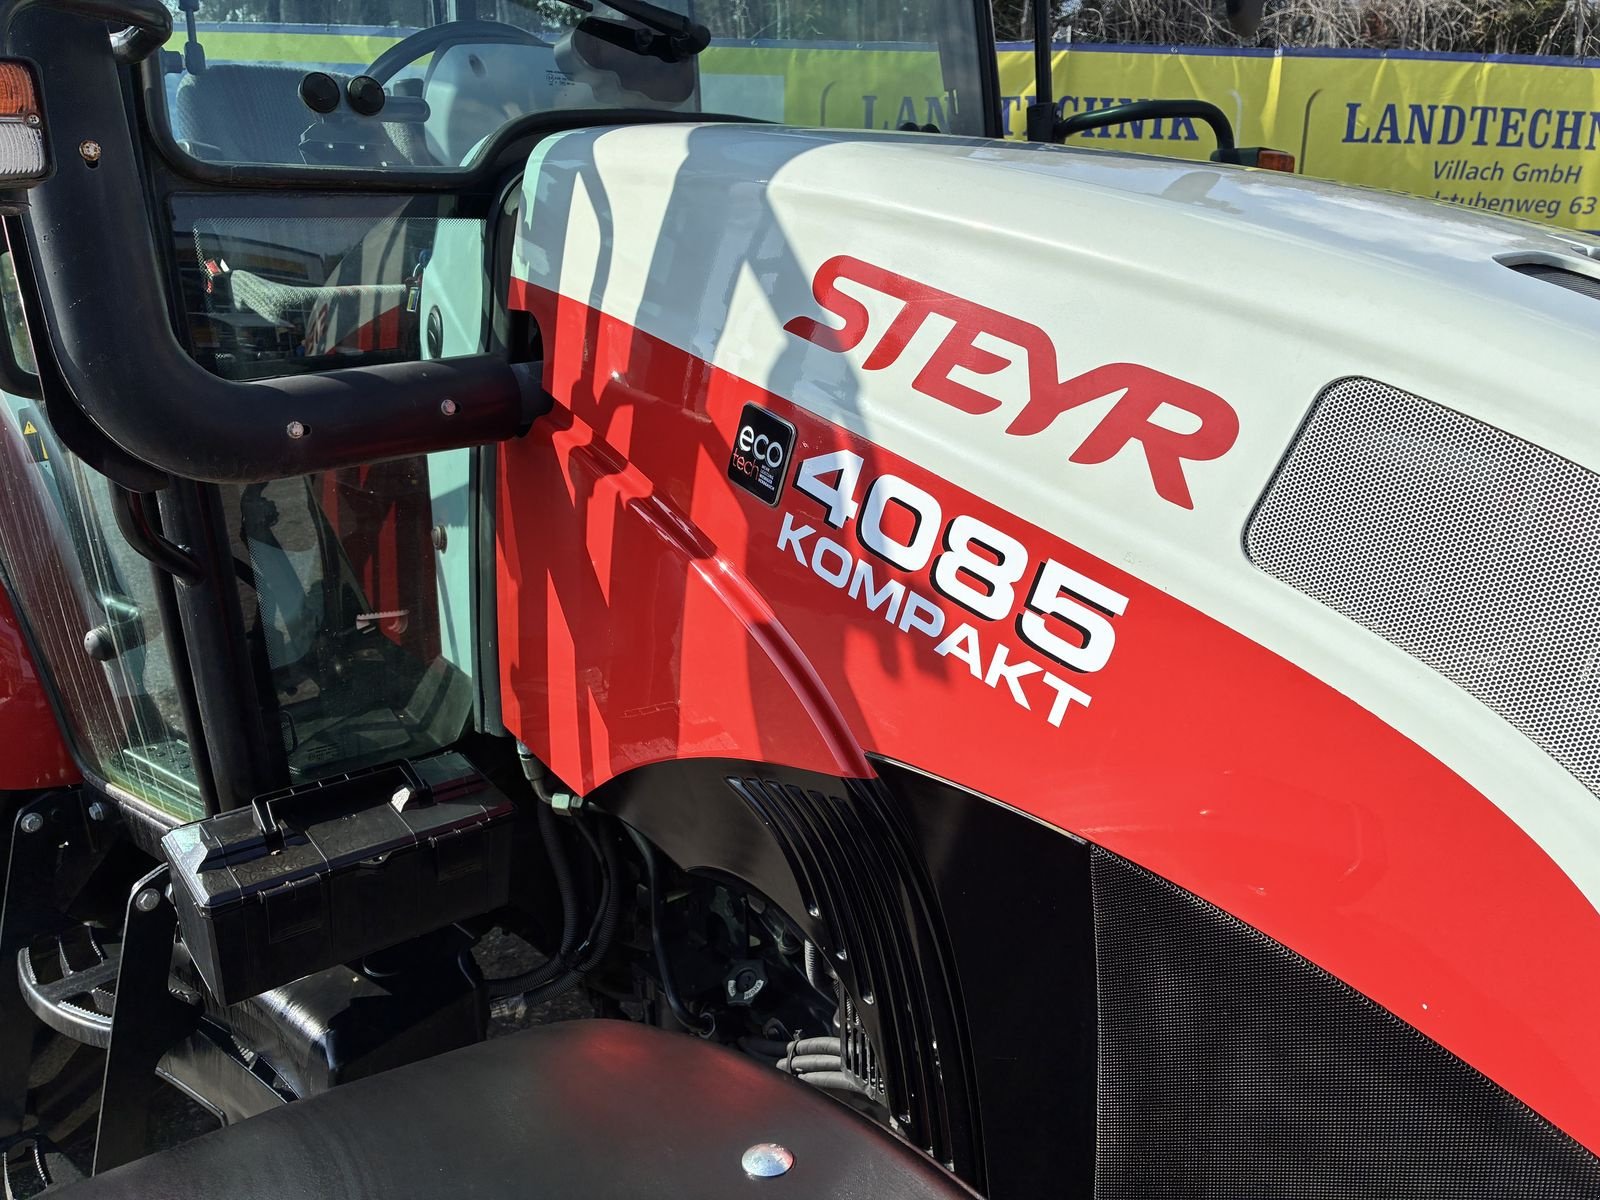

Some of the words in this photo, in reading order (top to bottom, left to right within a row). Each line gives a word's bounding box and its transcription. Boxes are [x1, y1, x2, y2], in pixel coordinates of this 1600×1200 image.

[862, 95, 1200, 141] LANTCHNIK
[1433, 160, 1504, 182] Villach
[1512, 163, 1583, 184] GmbH
[1569, 196, 1598, 215] 63
[783, 255, 1240, 511] STEYR
[732, 447, 760, 481] tech
[738, 425, 783, 468] eco
[792, 449, 1130, 674] 4085
[776, 511, 1092, 728] KOMPAKT
